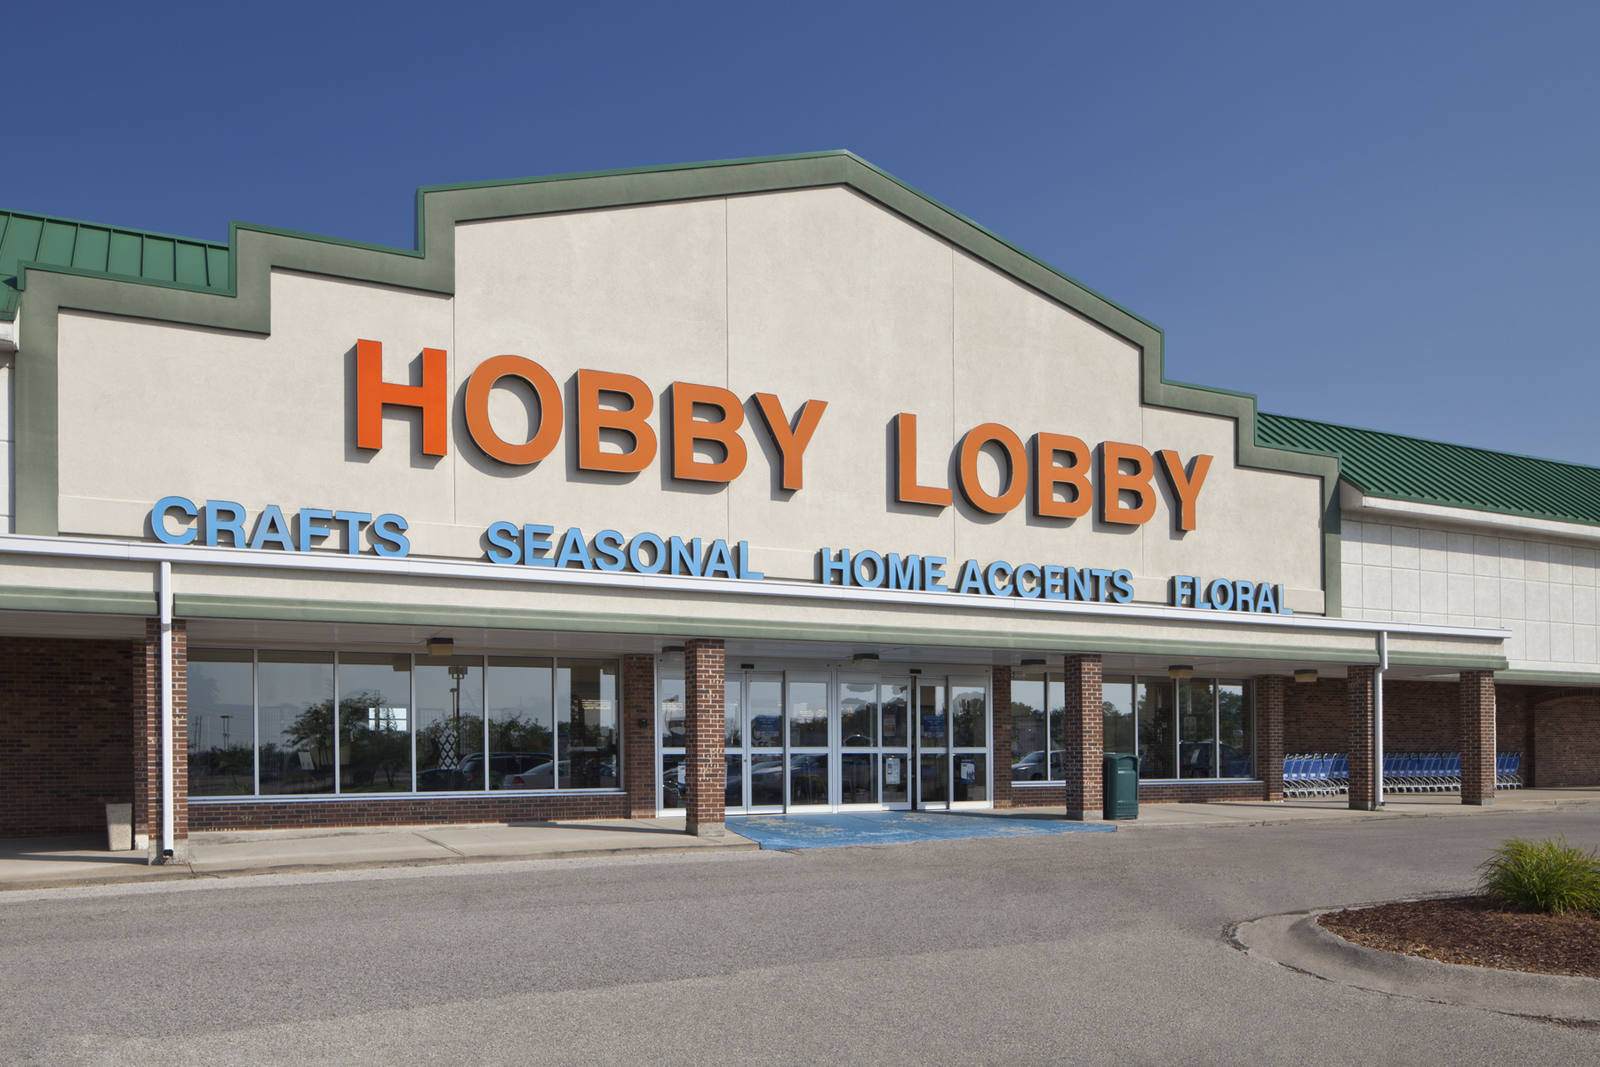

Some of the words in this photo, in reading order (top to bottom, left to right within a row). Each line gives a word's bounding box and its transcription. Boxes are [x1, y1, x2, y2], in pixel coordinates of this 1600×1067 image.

[356, 338, 827, 491] HOBBY
[896, 413, 1212, 531] LOBBY
[150, 495, 410, 557] CRAFTS
[485, 521, 764, 580] SEASONAL
[819, 546, 948, 592] HOME
[960, 559, 1134, 603] ACCENTS
[1173, 575, 1294, 615] FLORAL
